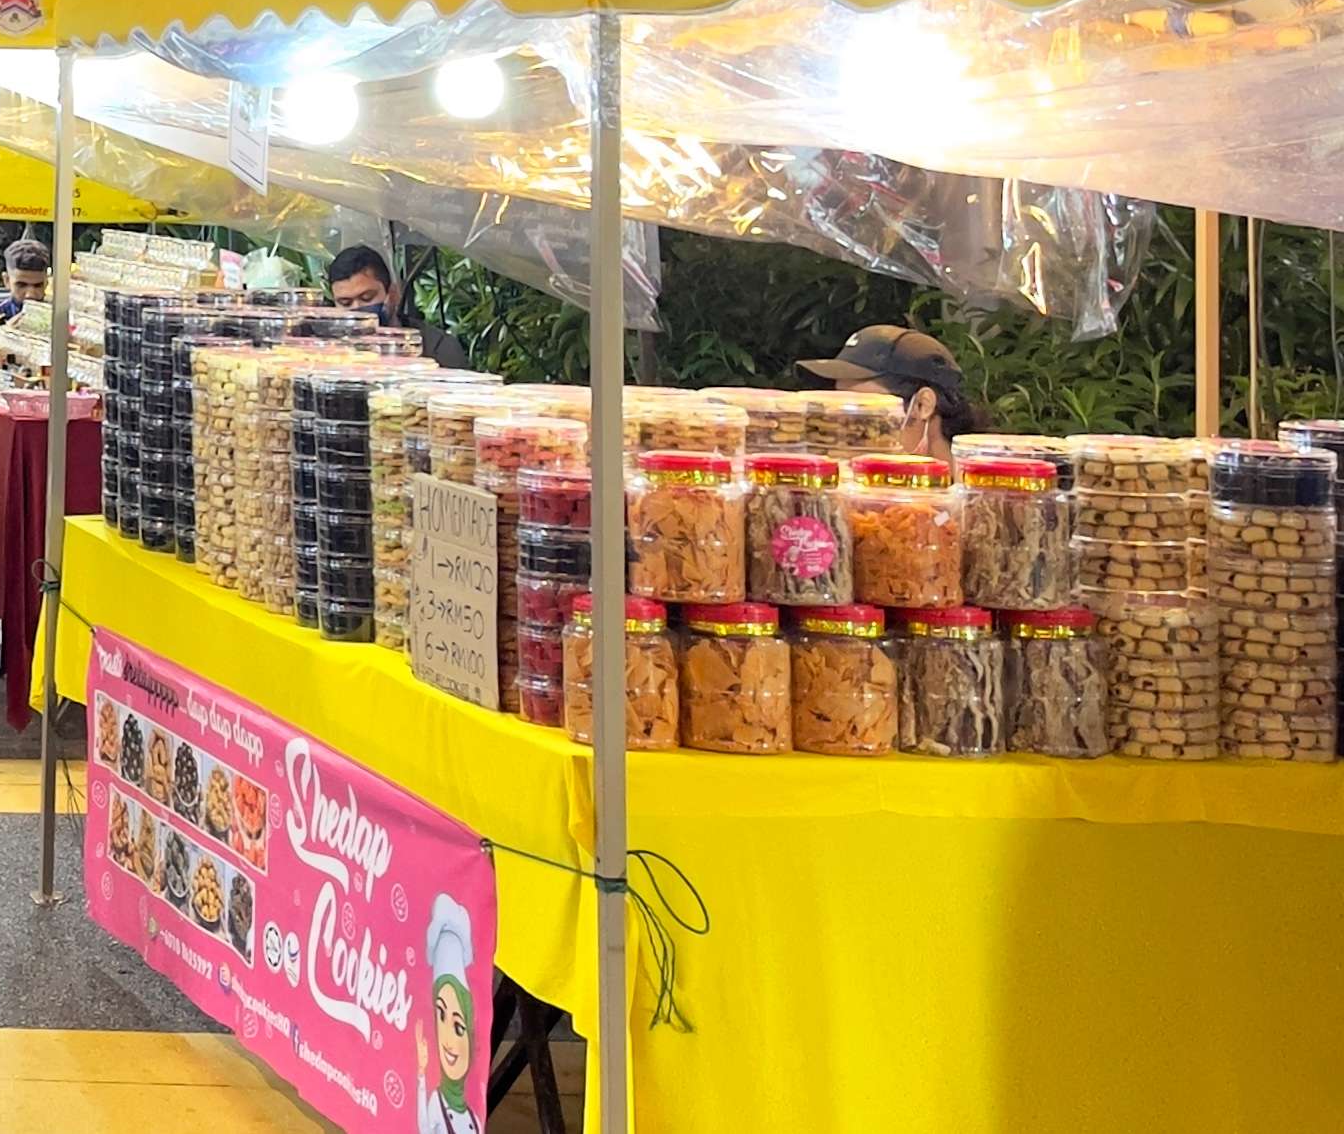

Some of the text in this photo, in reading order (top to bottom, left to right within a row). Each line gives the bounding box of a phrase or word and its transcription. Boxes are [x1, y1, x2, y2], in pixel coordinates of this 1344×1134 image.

[418, 481, 496, 549] HOMEMADE
[454, 556, 495, 595] RM20
[427, 589, 485, 641] 3 RM50
[424, 631, 486, 680] 6 RM100
[209, 699, 232, 749] dap
[233, 713, 264, 768] dapp
[284, 736, 392, 902] Shedap
[307, 880, 414, 1042] Cookies
